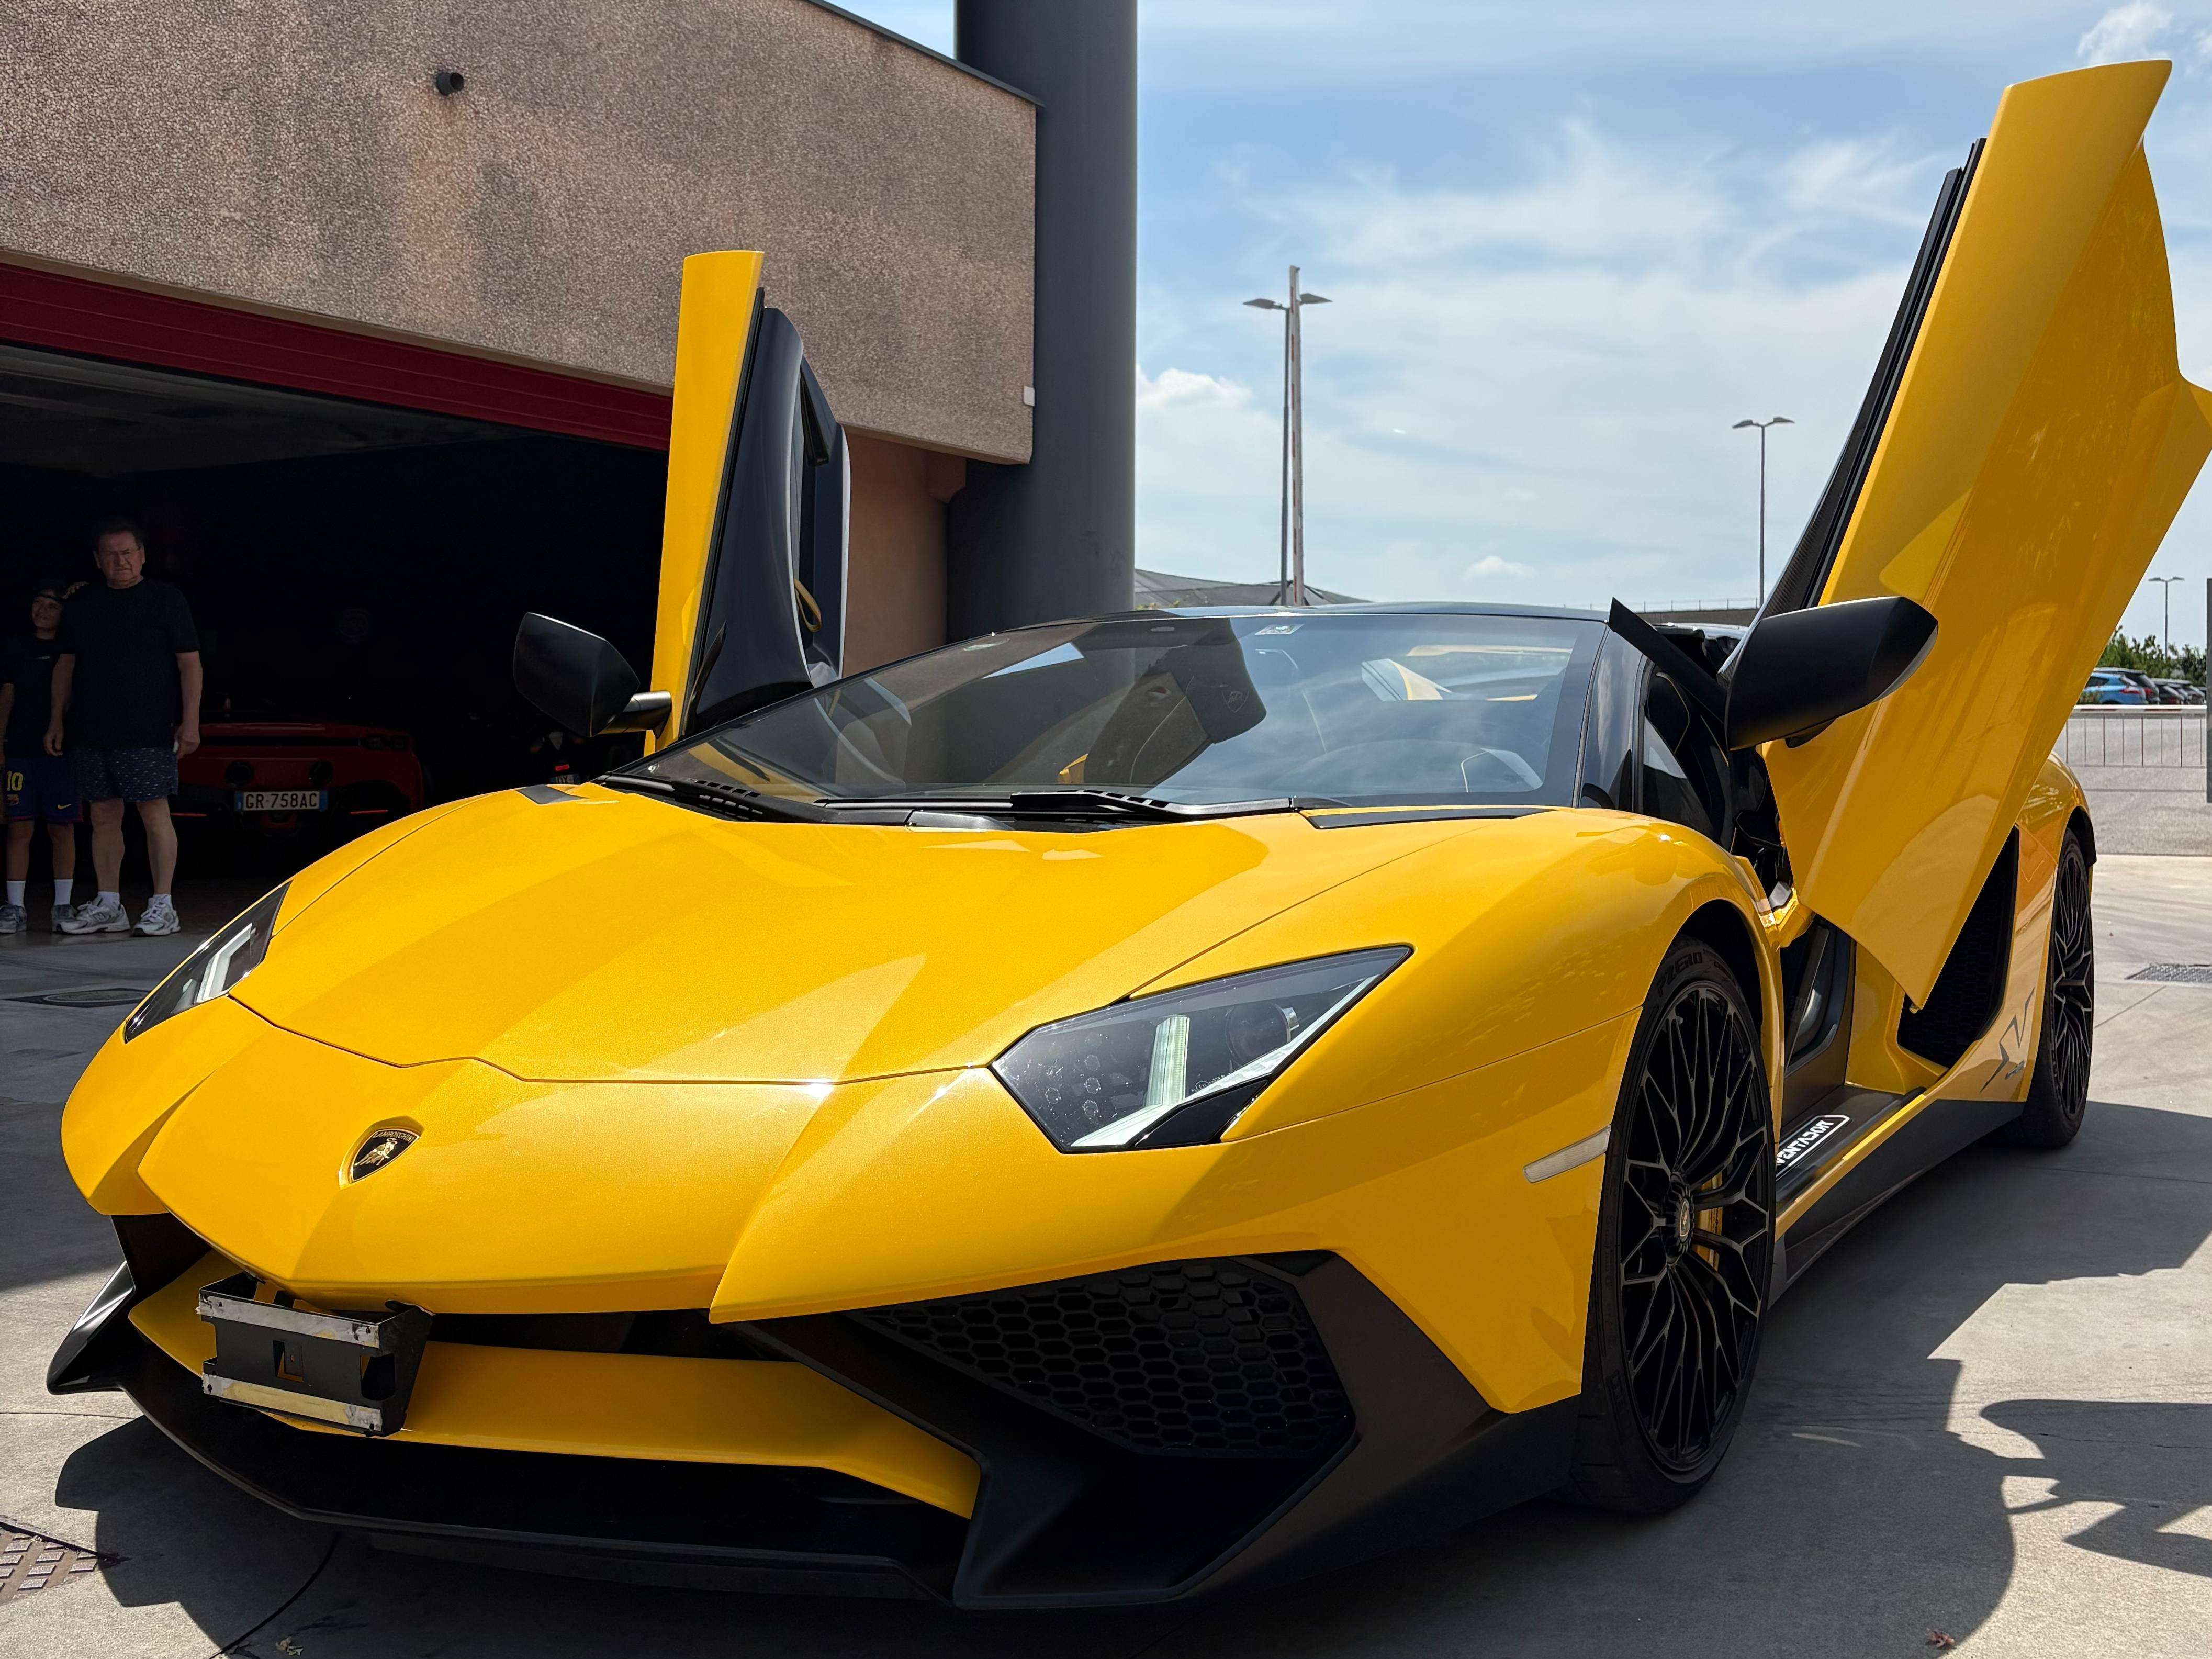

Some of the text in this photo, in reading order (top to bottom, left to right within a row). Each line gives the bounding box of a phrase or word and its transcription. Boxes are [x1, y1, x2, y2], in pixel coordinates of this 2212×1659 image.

[6, 770, 24, 791] 10
[245, 793, 317, 809] GR 758AC
[1776, 1120, 1834, 1165] VENTADOR
